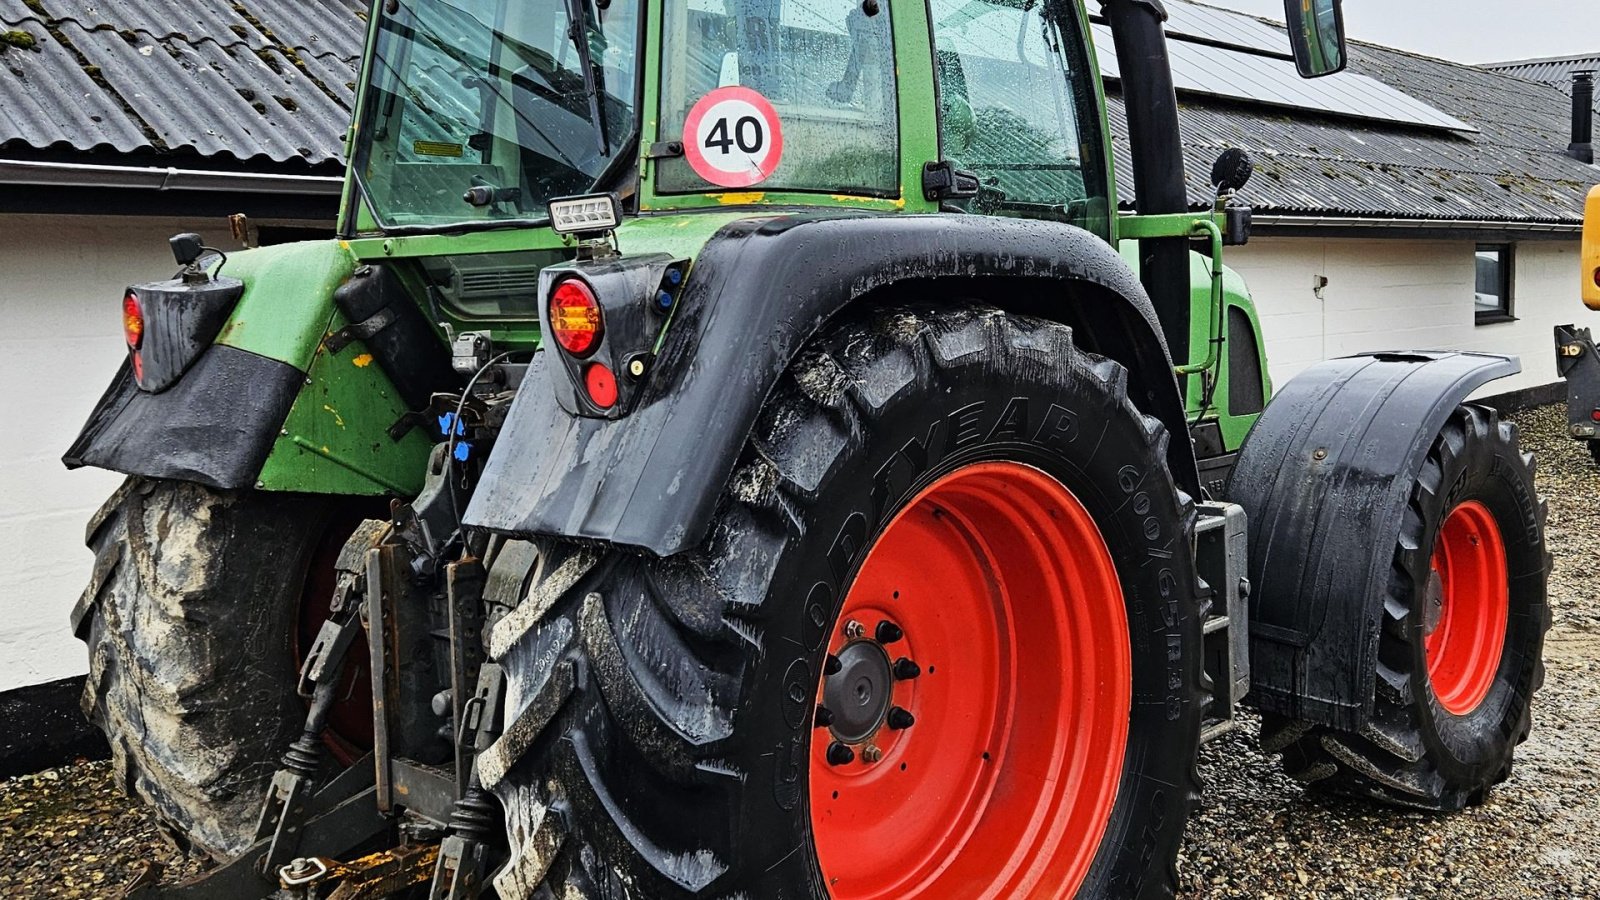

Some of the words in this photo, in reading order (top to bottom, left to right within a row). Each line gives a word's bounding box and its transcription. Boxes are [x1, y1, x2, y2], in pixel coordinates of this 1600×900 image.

[704, 115, 764, 155] 40
[772, 396, 1081, 812] GOODYEAR
[1117, 464, 1183, 721] 600/65R38
